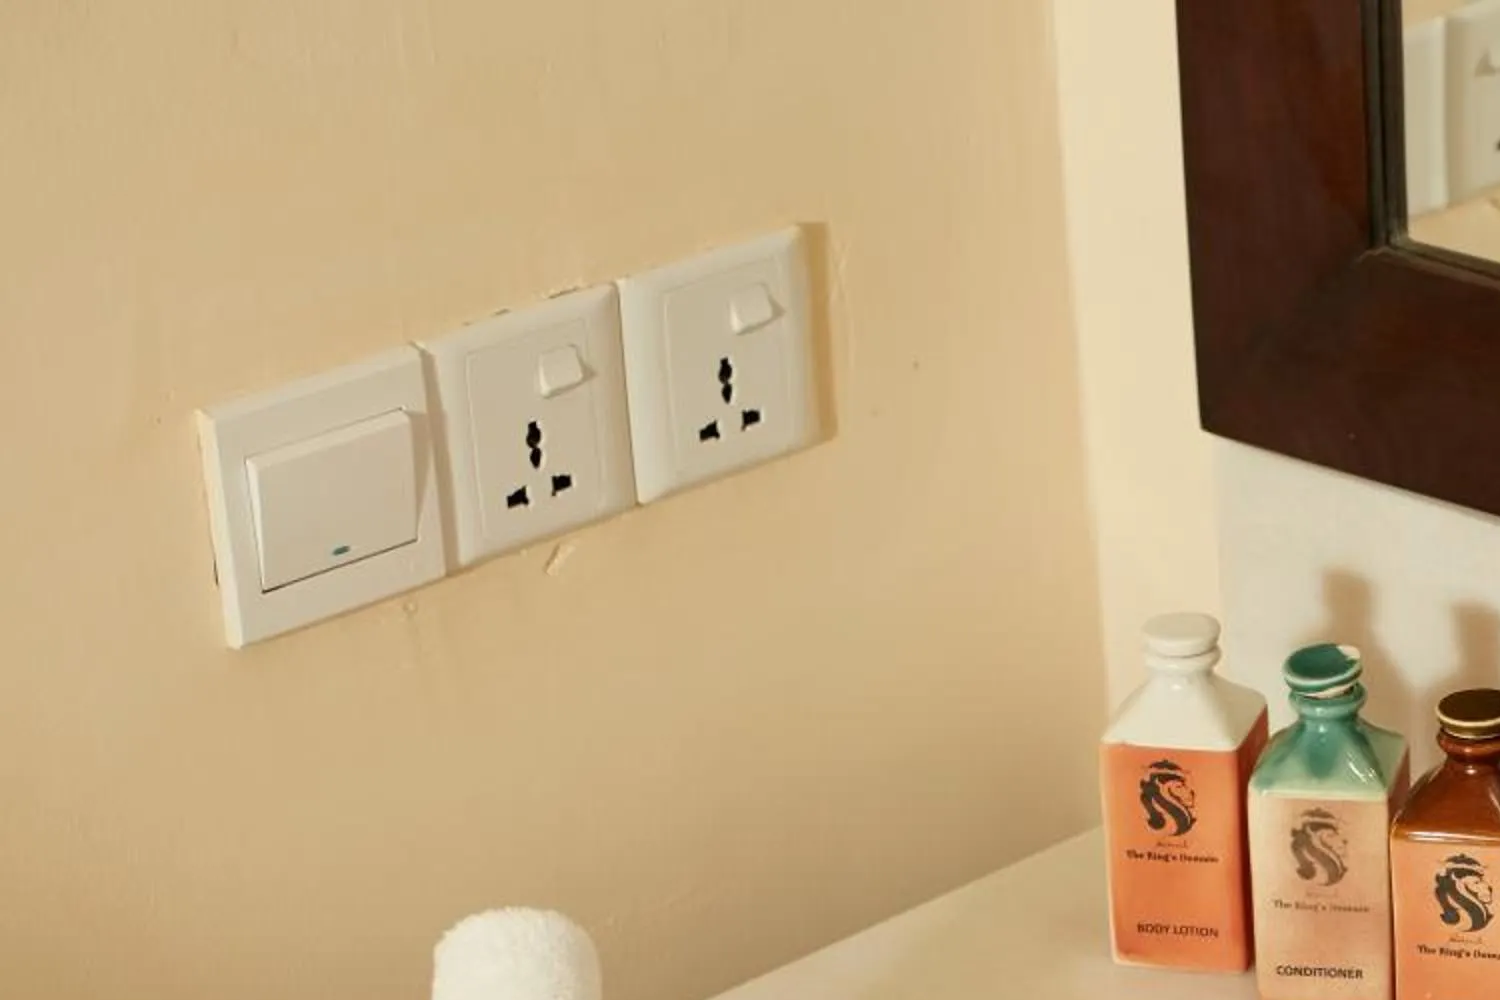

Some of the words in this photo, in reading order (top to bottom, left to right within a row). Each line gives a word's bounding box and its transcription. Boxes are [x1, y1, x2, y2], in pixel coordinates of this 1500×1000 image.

[1137, 922, 1170, 936] BODY
[1173, 924, 1219, 939] LOTION
[1417, 944, 1437, 954] The
[1276, 964, 1364, 980] CONDITIONER
